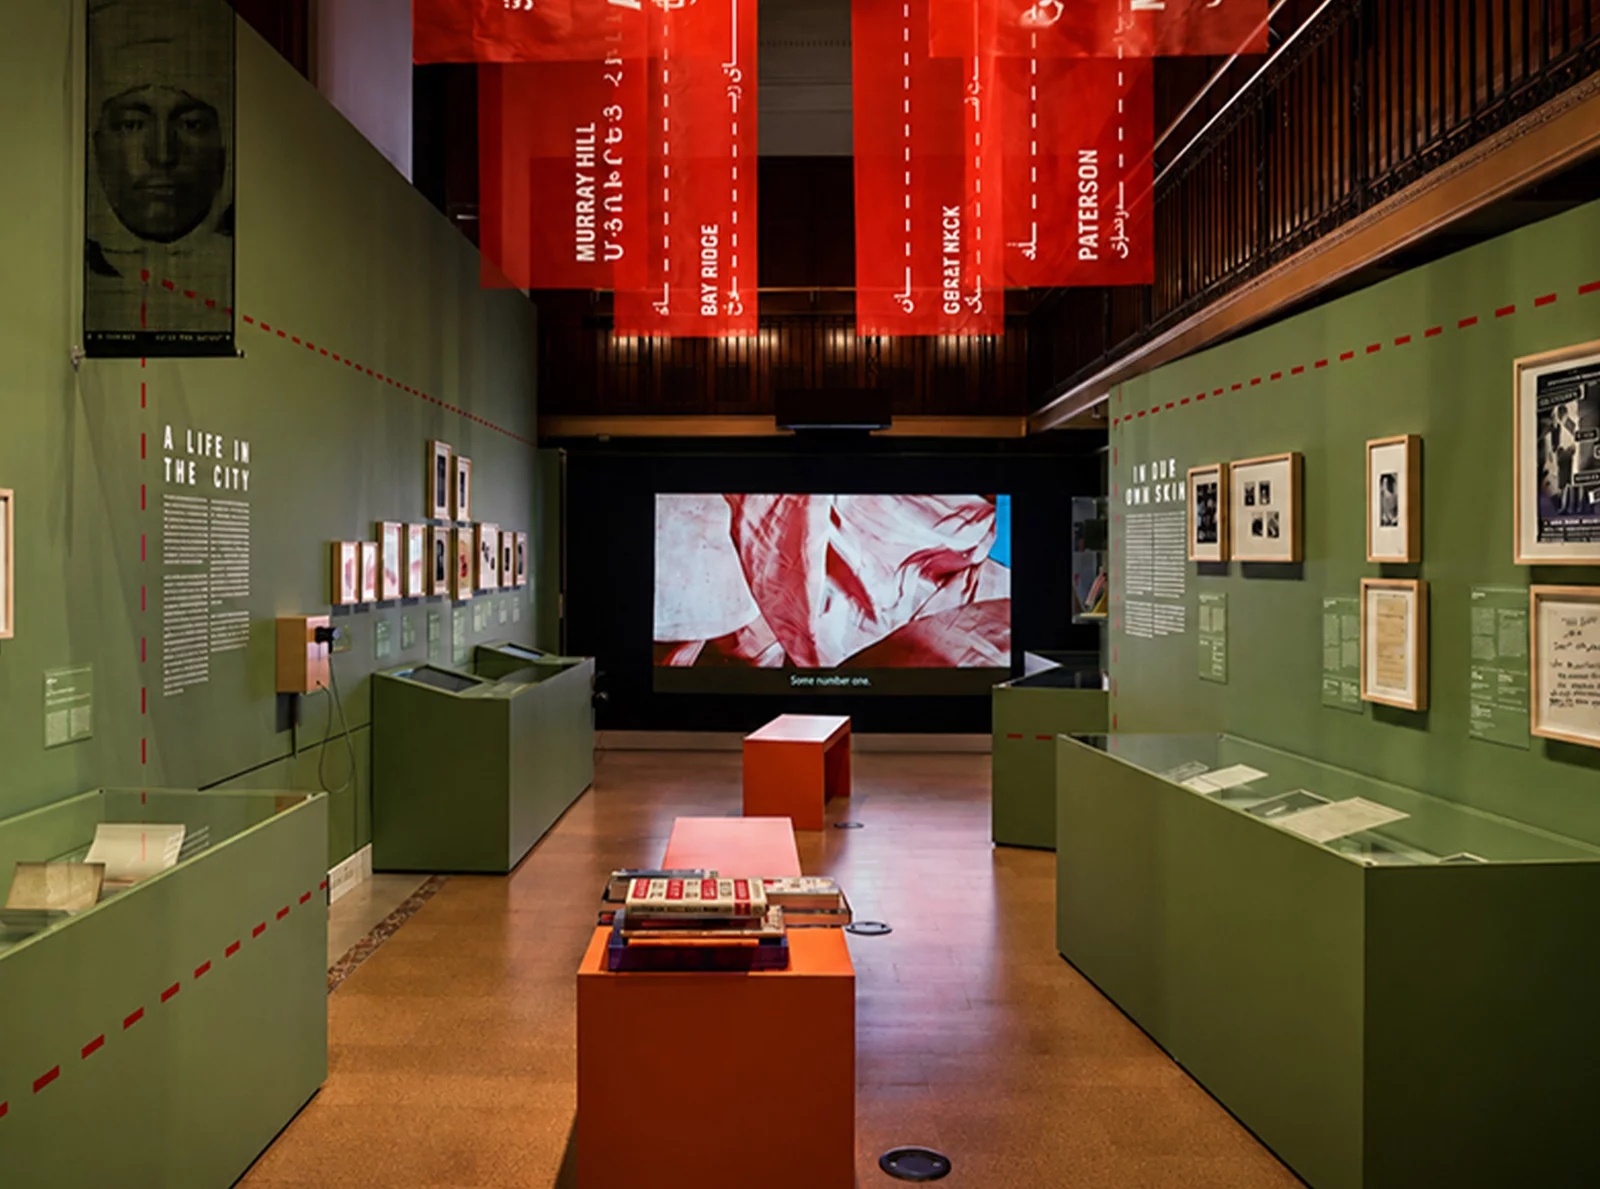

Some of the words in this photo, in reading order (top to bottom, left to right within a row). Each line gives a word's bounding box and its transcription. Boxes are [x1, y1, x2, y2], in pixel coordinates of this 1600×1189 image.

[576, 122, 596, 167] HILL
[576, 172, 596, 262] MURRAY
[1078, 149, 1098, 260] PATERSON
[700, 224, 718, 278] RIDGE
[700, 282, 718, 316] BAY
[163, 424, 174, 450] A
[186, 429, 223, 459] LIFE
[233, 439, 250, 464] IN
[163, 457, 196, 485] THE
[213, 464, 250, 491] CITY
[790, 674, 814, 686] Some
[816, 675, 850, 686] number
